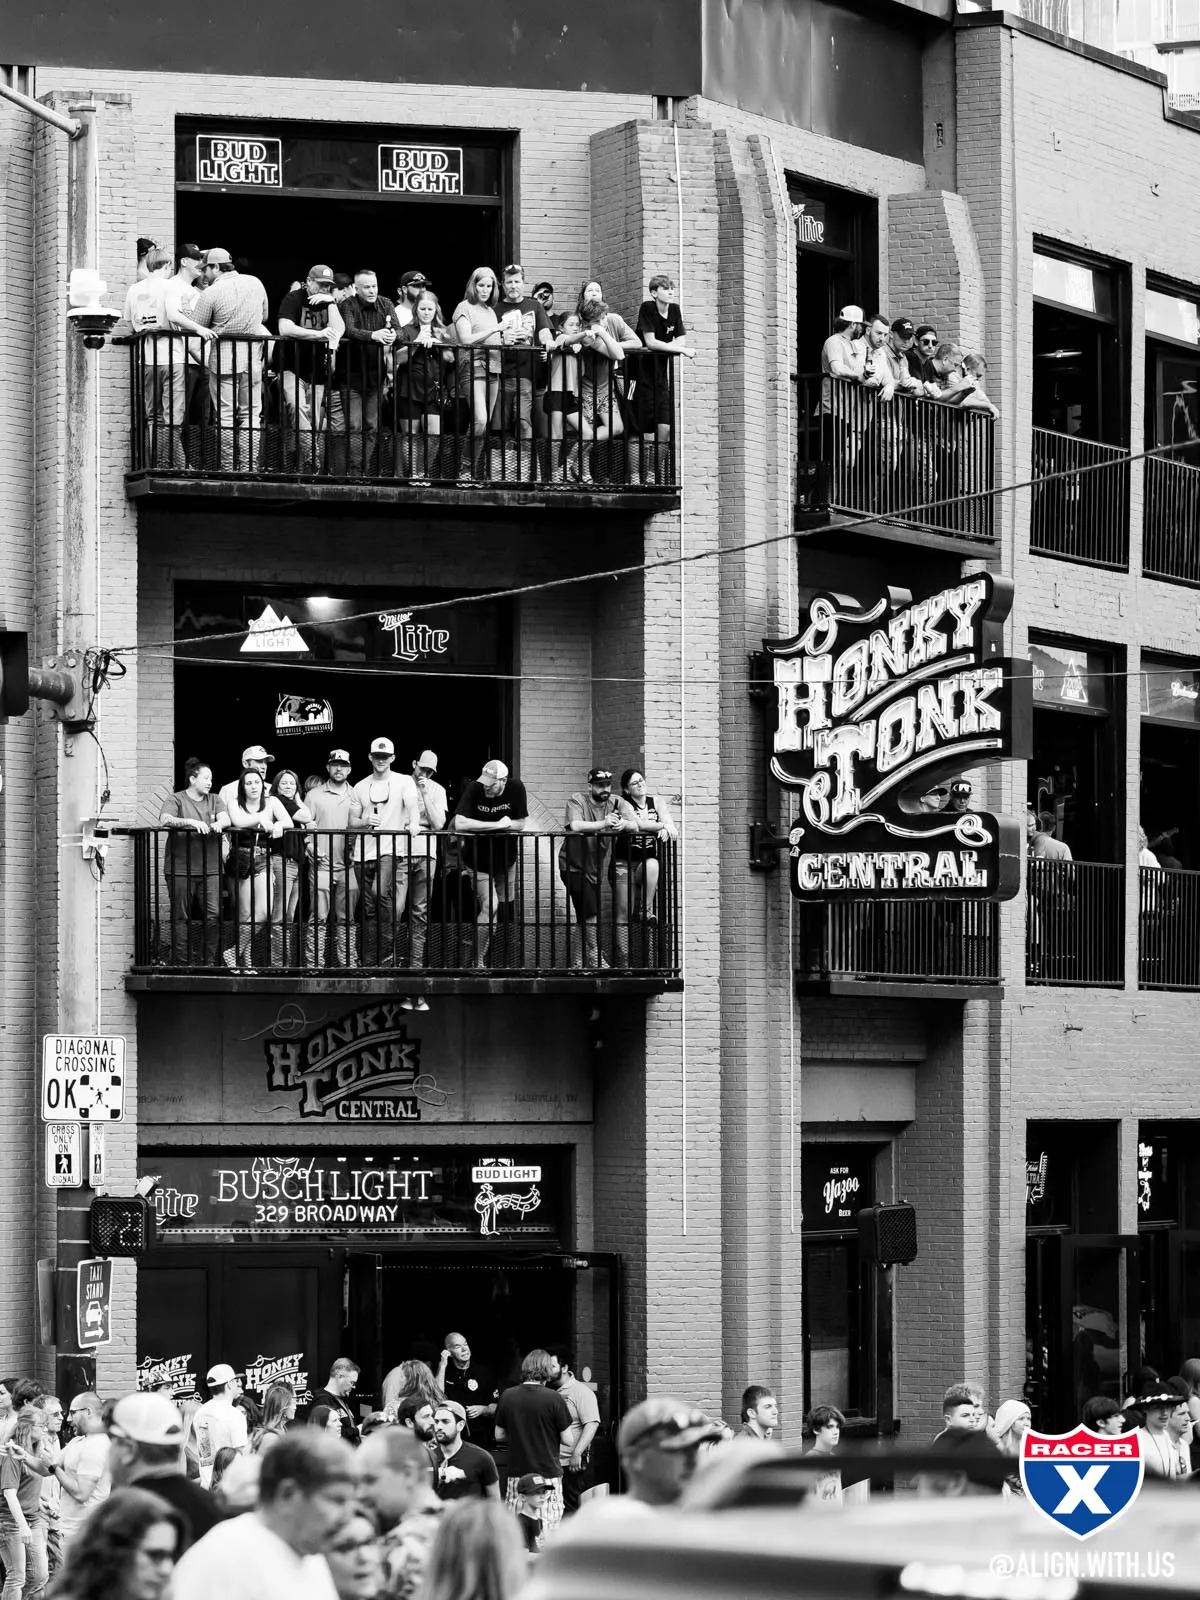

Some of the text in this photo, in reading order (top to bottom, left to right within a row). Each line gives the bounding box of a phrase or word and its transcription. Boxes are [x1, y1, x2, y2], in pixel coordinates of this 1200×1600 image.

[211, 140, 267, 162] BUD
[393, 149, 449, 172] BUD
[379, 612, 414, 631] Miller
[256, 638, 290, 648] LIGHT
[392, 624, 450, 661] Lite
[773, 579, 986, 753] HONKY
[814, 667, 1003, 823] TONK
[799, 851, 988, 890] CENTRAL
[56, 1039, 116, 1056] DIAGONAL
[270, 1003, 400, 1086] HONKY
[56, 1056, 115, 1072] CROSSING
[294, 1044, 415, 1113] TONK
[47, 1078, 76, 1109] OK
[339, 1100, 418, 1118] CENTRAL
[51, 1126, 75, 1134] CROSS
[53, 1135, 72, 1144] ONLY
[58, 1144, 69, 1153] ON
[52, 1176, 76, 1184] SIGNAL
[476, 1169, 538, 1179] BUD LIGHT
[840, 1166, 849, 1174] FOR
[218, 1170, 433, 1202] BUSCH LIGHT
[823, 1177, 860, 1214] Yazoo
[149, 1188, 199, 1225] ite
[255, 1204, 398, 1223] 329 BROADWAY
[89, 1265, 103, 1282] TAXI
[86, 1282, 104, 1300] STAND
[246, 1353, 303, 1389] HONKY
[257, 1372, 308, 1404] TNK
